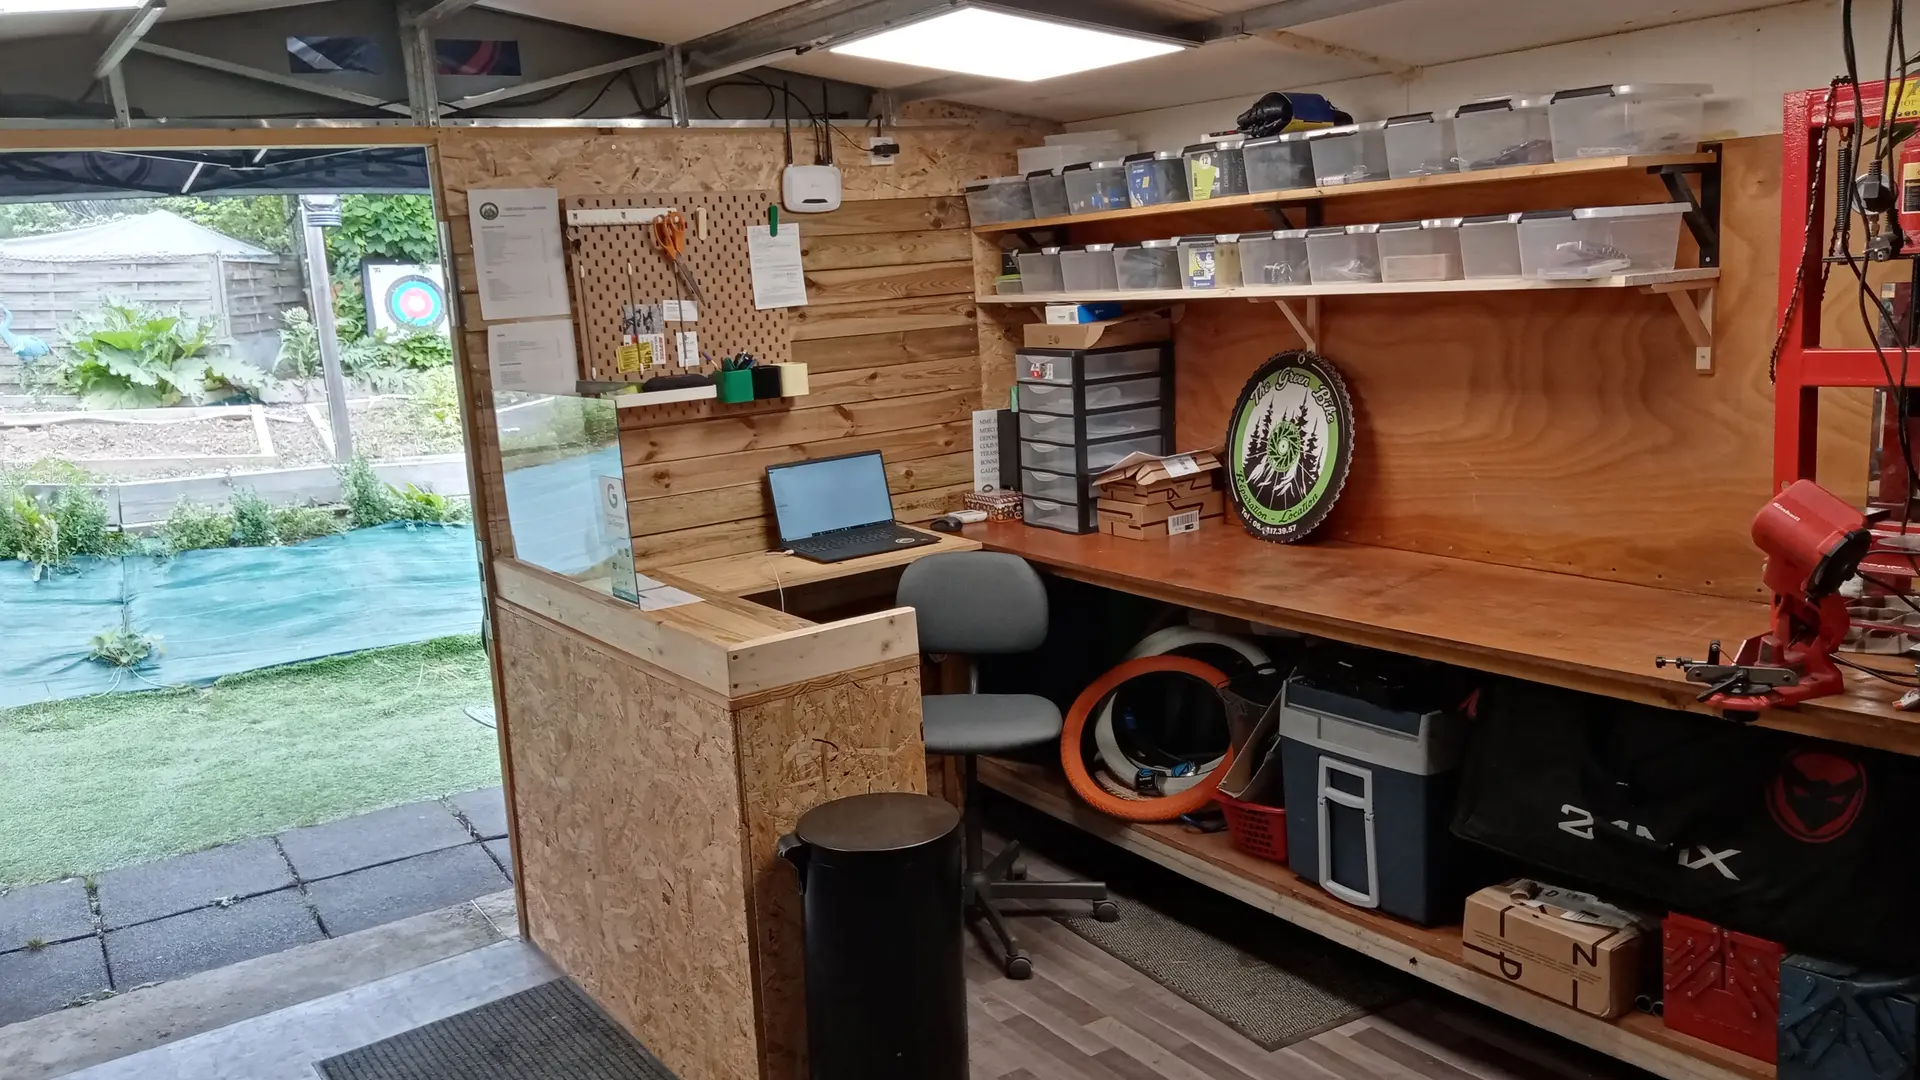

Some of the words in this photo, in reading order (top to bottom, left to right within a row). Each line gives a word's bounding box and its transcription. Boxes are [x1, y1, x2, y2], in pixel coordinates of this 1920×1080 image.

[1201, 156, 1209, 166] 12
[1250, 380, 1271, 407] The
[1275, 366, 1310, 390] Green
[1312, 385, 1337, 425] Bike
[1235, 471, 1268, 521] Réparation
[1278, 493, 1318, 524] Location
[1241, 507, 1250, 520] Tel
